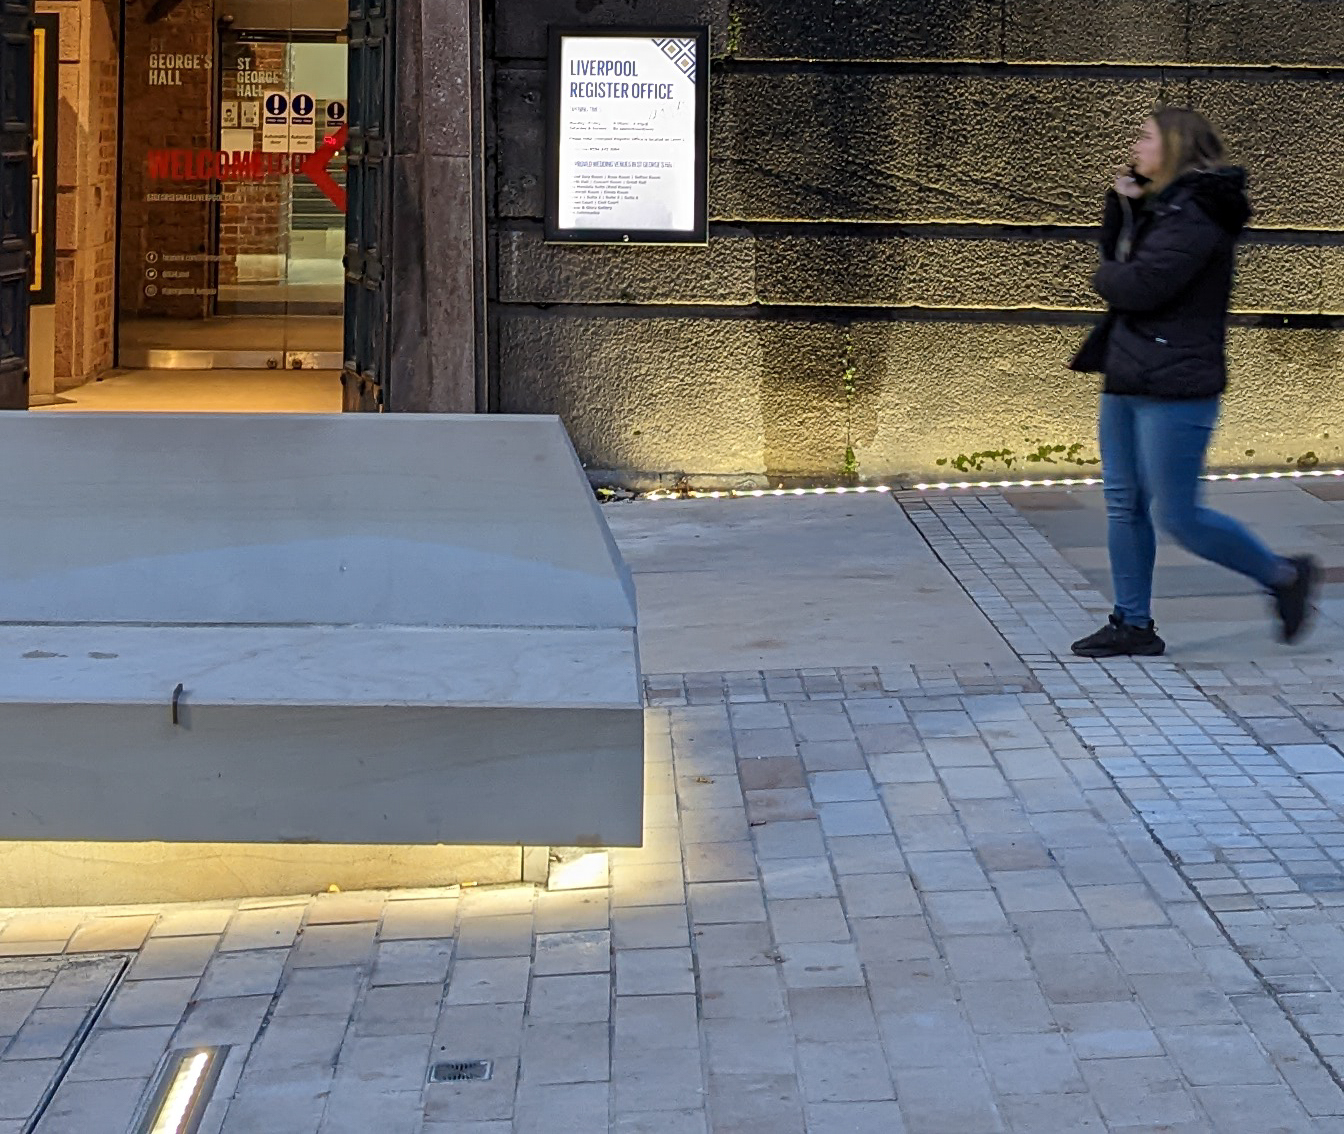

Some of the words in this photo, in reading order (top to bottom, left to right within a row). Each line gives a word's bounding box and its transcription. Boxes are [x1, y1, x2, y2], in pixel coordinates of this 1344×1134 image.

[149, 53, 212, 69] GEORGE'S
[237, 57, 251, 70] ST
[570, 60, 638, 77] LIVERPOOL
[149, 70, 182, 85] HALL
[237, 85, 263, 97] HALL
[570, 82, 629, 98] REGISTER
[631, 83, 674, 100] OFFICE
